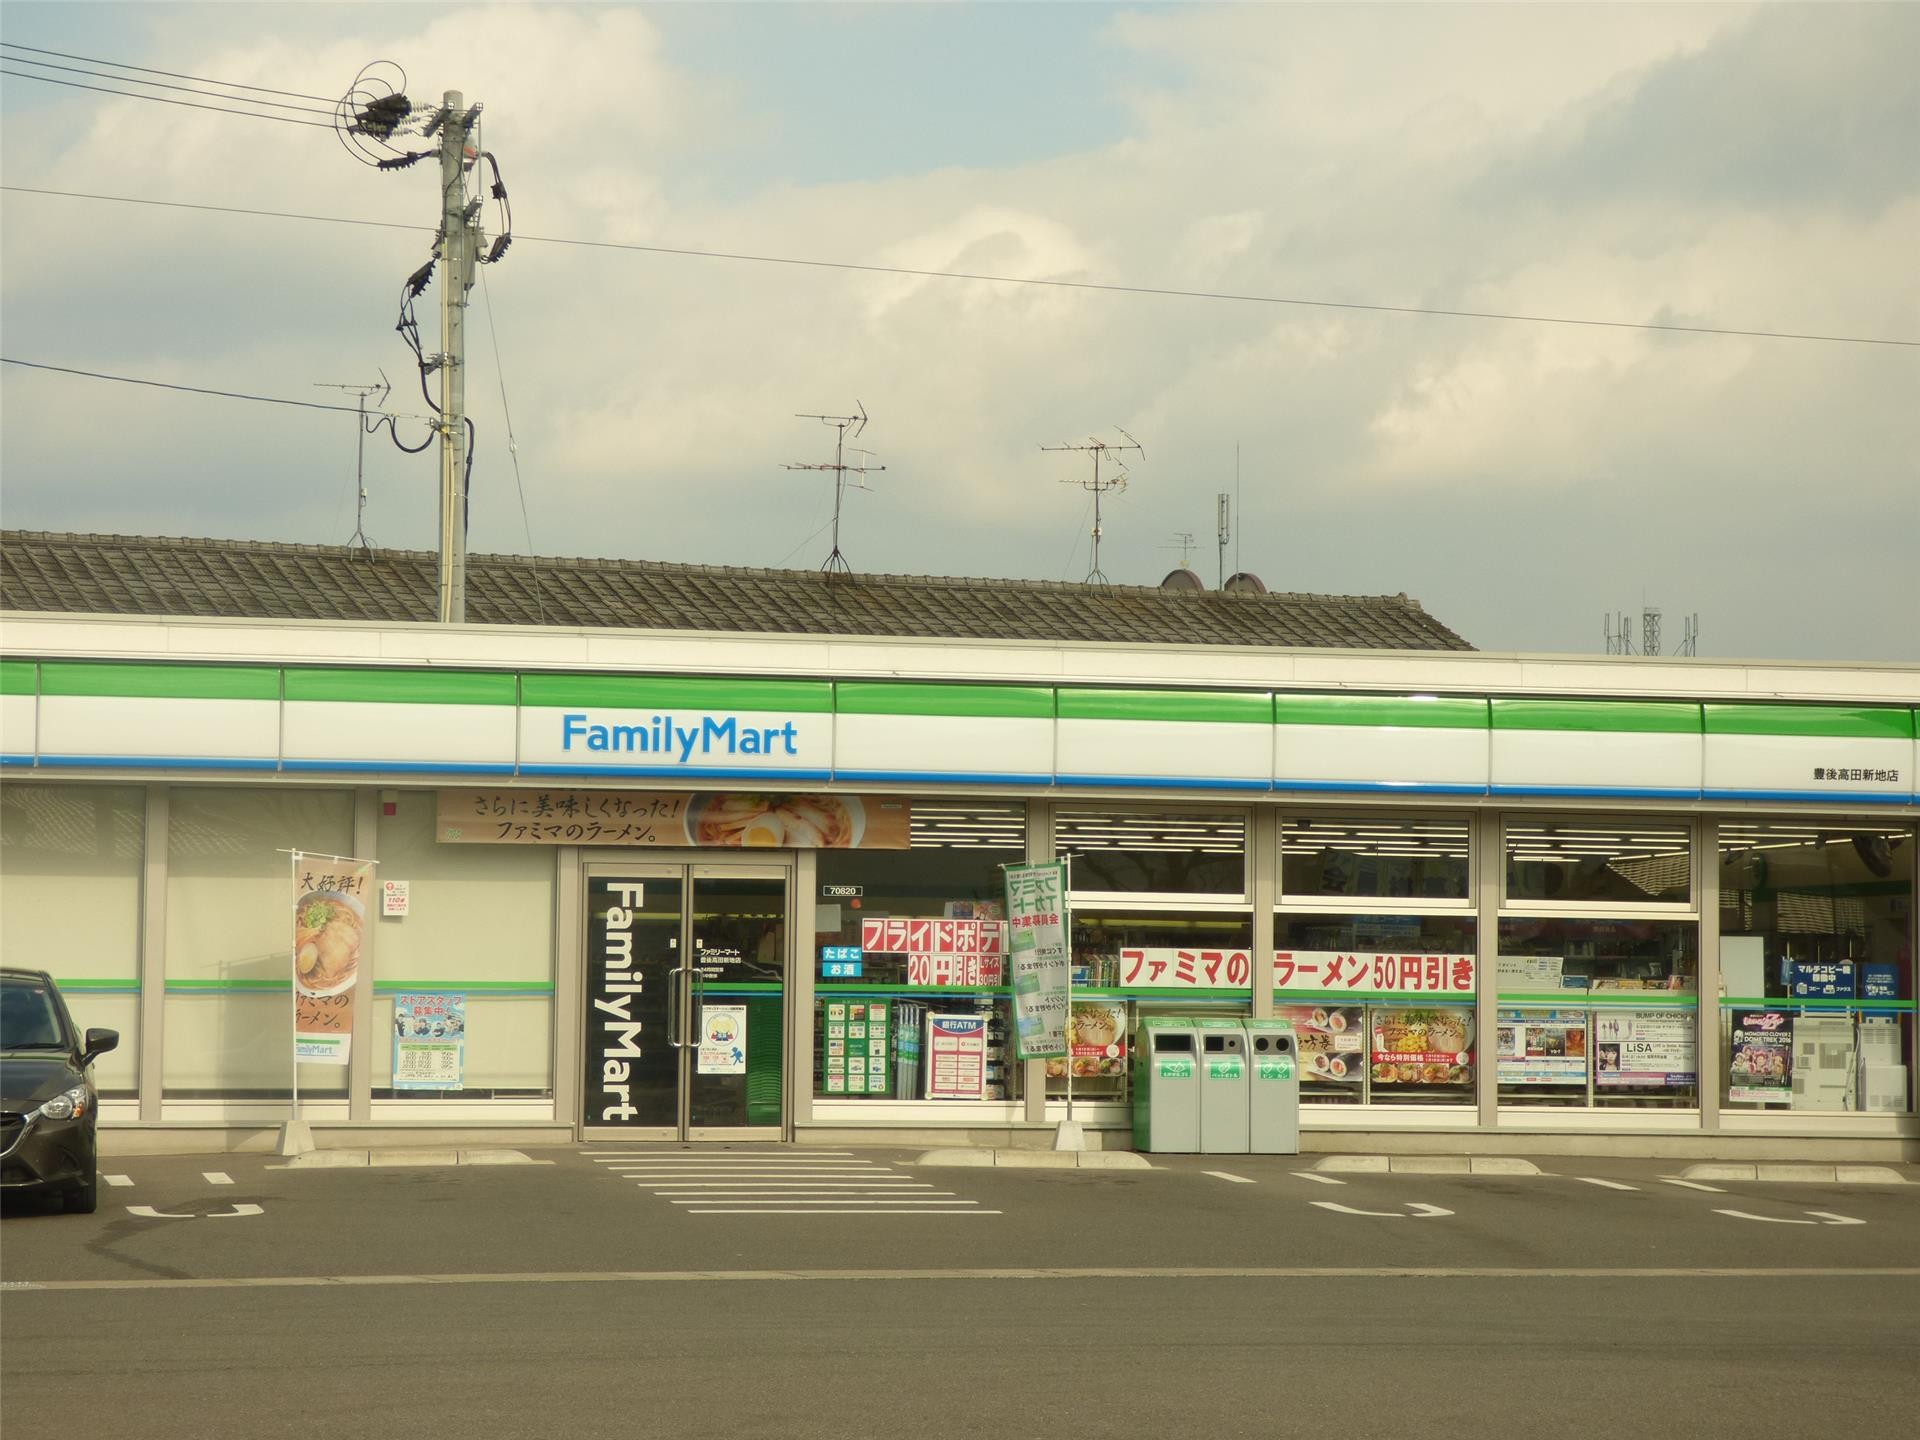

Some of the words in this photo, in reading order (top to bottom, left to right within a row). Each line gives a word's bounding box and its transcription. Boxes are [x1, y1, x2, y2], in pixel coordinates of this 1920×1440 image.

[561, 713, 798, 763] FamilyMart
[474, 794, 681, 818] さらに美味しくなった!
[497, 821, 657, 843] ファミマのラーメン。
[301, 872, 364, 895] 大好評!
[830, 887, 856, 895] 70820
[825, 947, 860, 959] たばこ
[831, 963, 855, 976] お酒
[910, 955, 977, 986] 20円引き
[1122, 950, 1249, 986] ファミマの
[1274, 952, 1474, 991] ラーメン50円引き
[594, 882, 645, 1121] FamilyMart
[941, 1019, 977, 1031] 銀行ATM
[1626, 1043, 1653, 1053] LiSA
